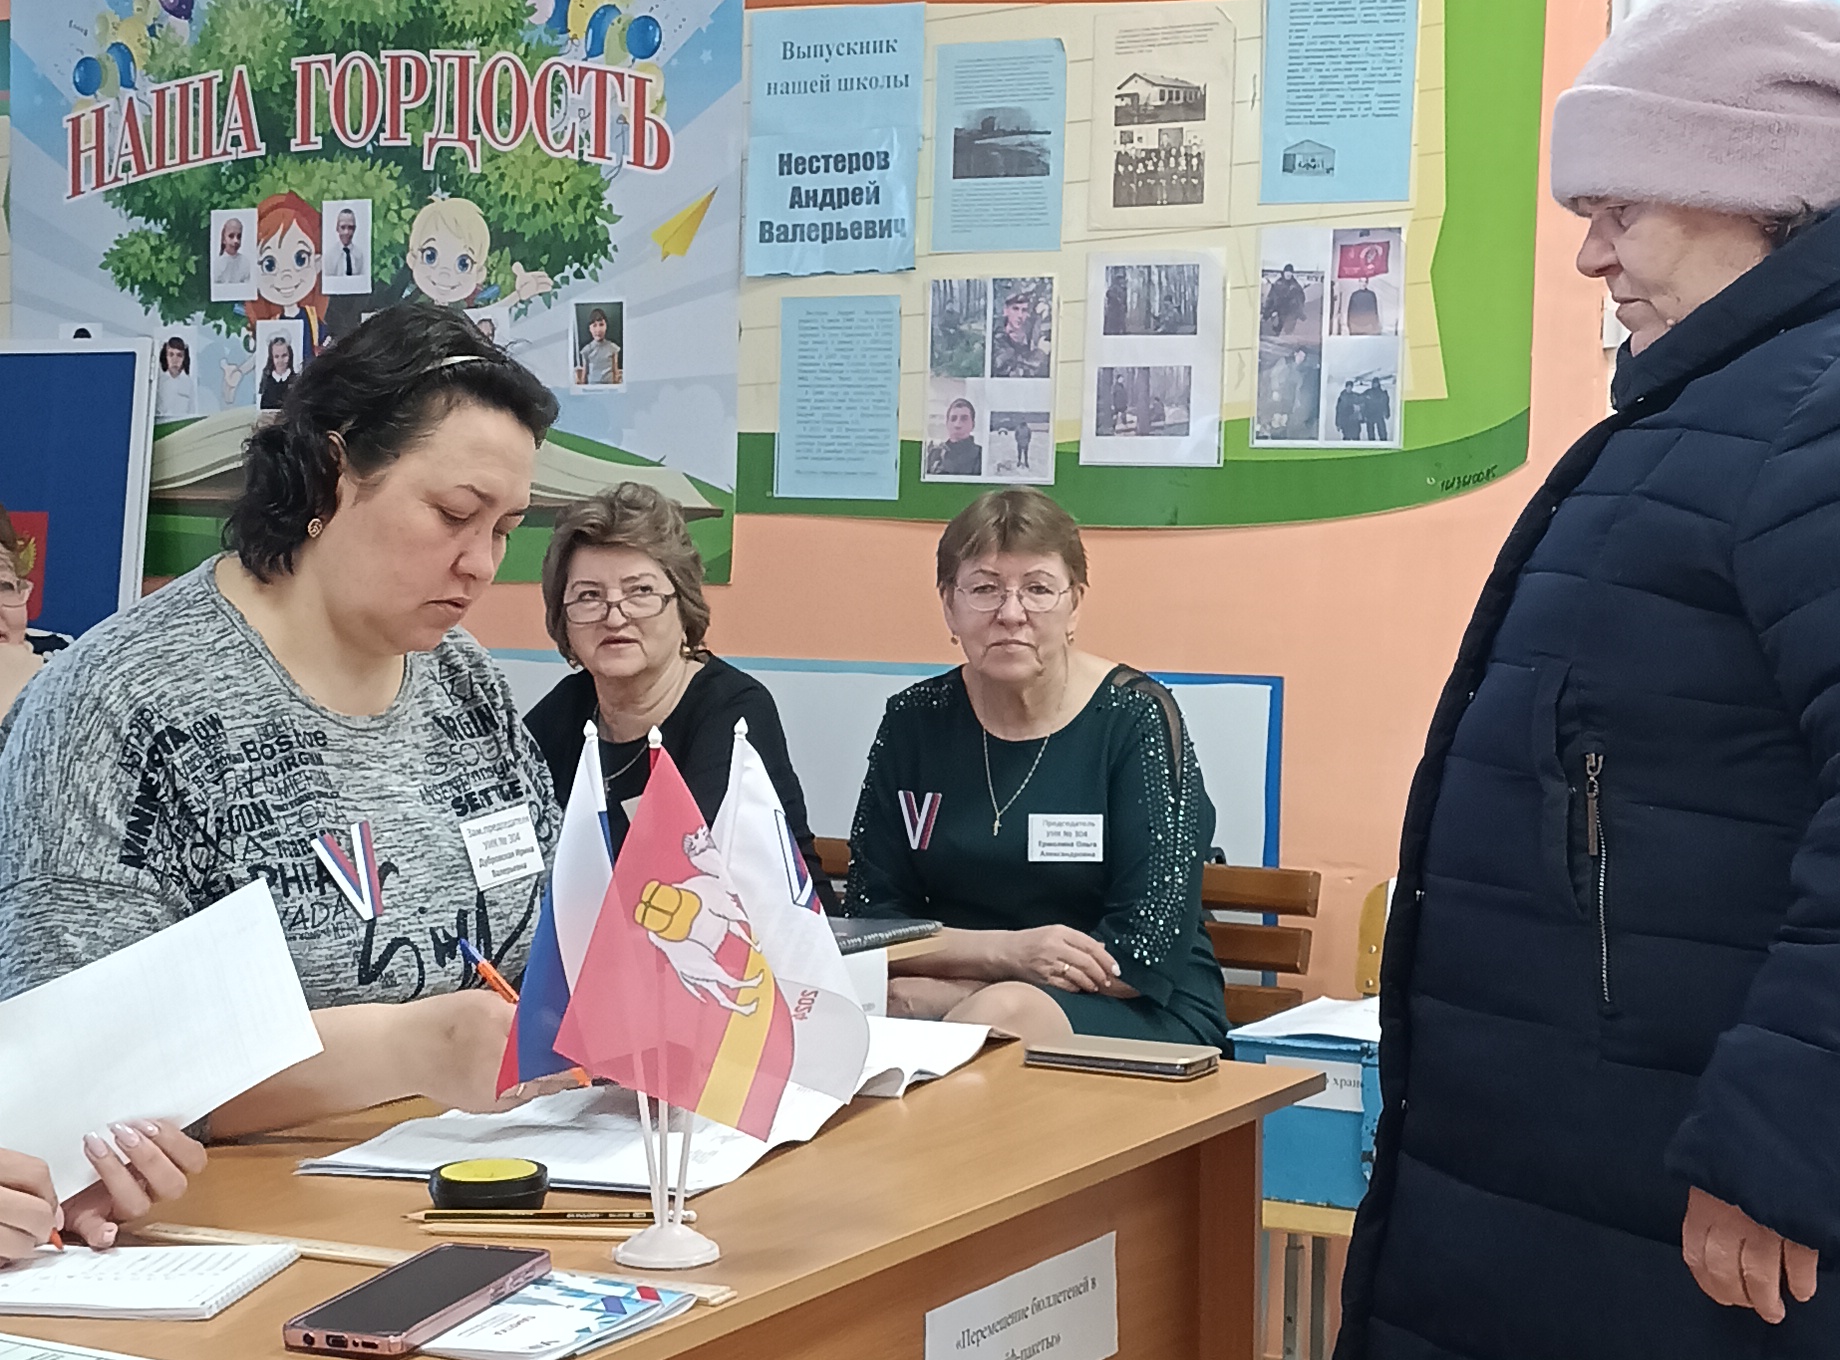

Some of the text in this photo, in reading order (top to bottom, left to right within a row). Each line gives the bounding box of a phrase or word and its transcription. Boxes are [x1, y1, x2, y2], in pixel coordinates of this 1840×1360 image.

[782, 38, 898, 63] Выпускник
[766, 73, 910, 96] нашей школы
[63, 50, 674, 202] НАША ГОРДОСТЬ
[778, 150, 891, 176] Нестеров
[788, 180, 881, 211] Андрей
[758, 218, 907, 244] Валерьевич
[1030, 1275, 1090, 1316] бюллетеней
[1090, 1276, 1097, 1290] в
